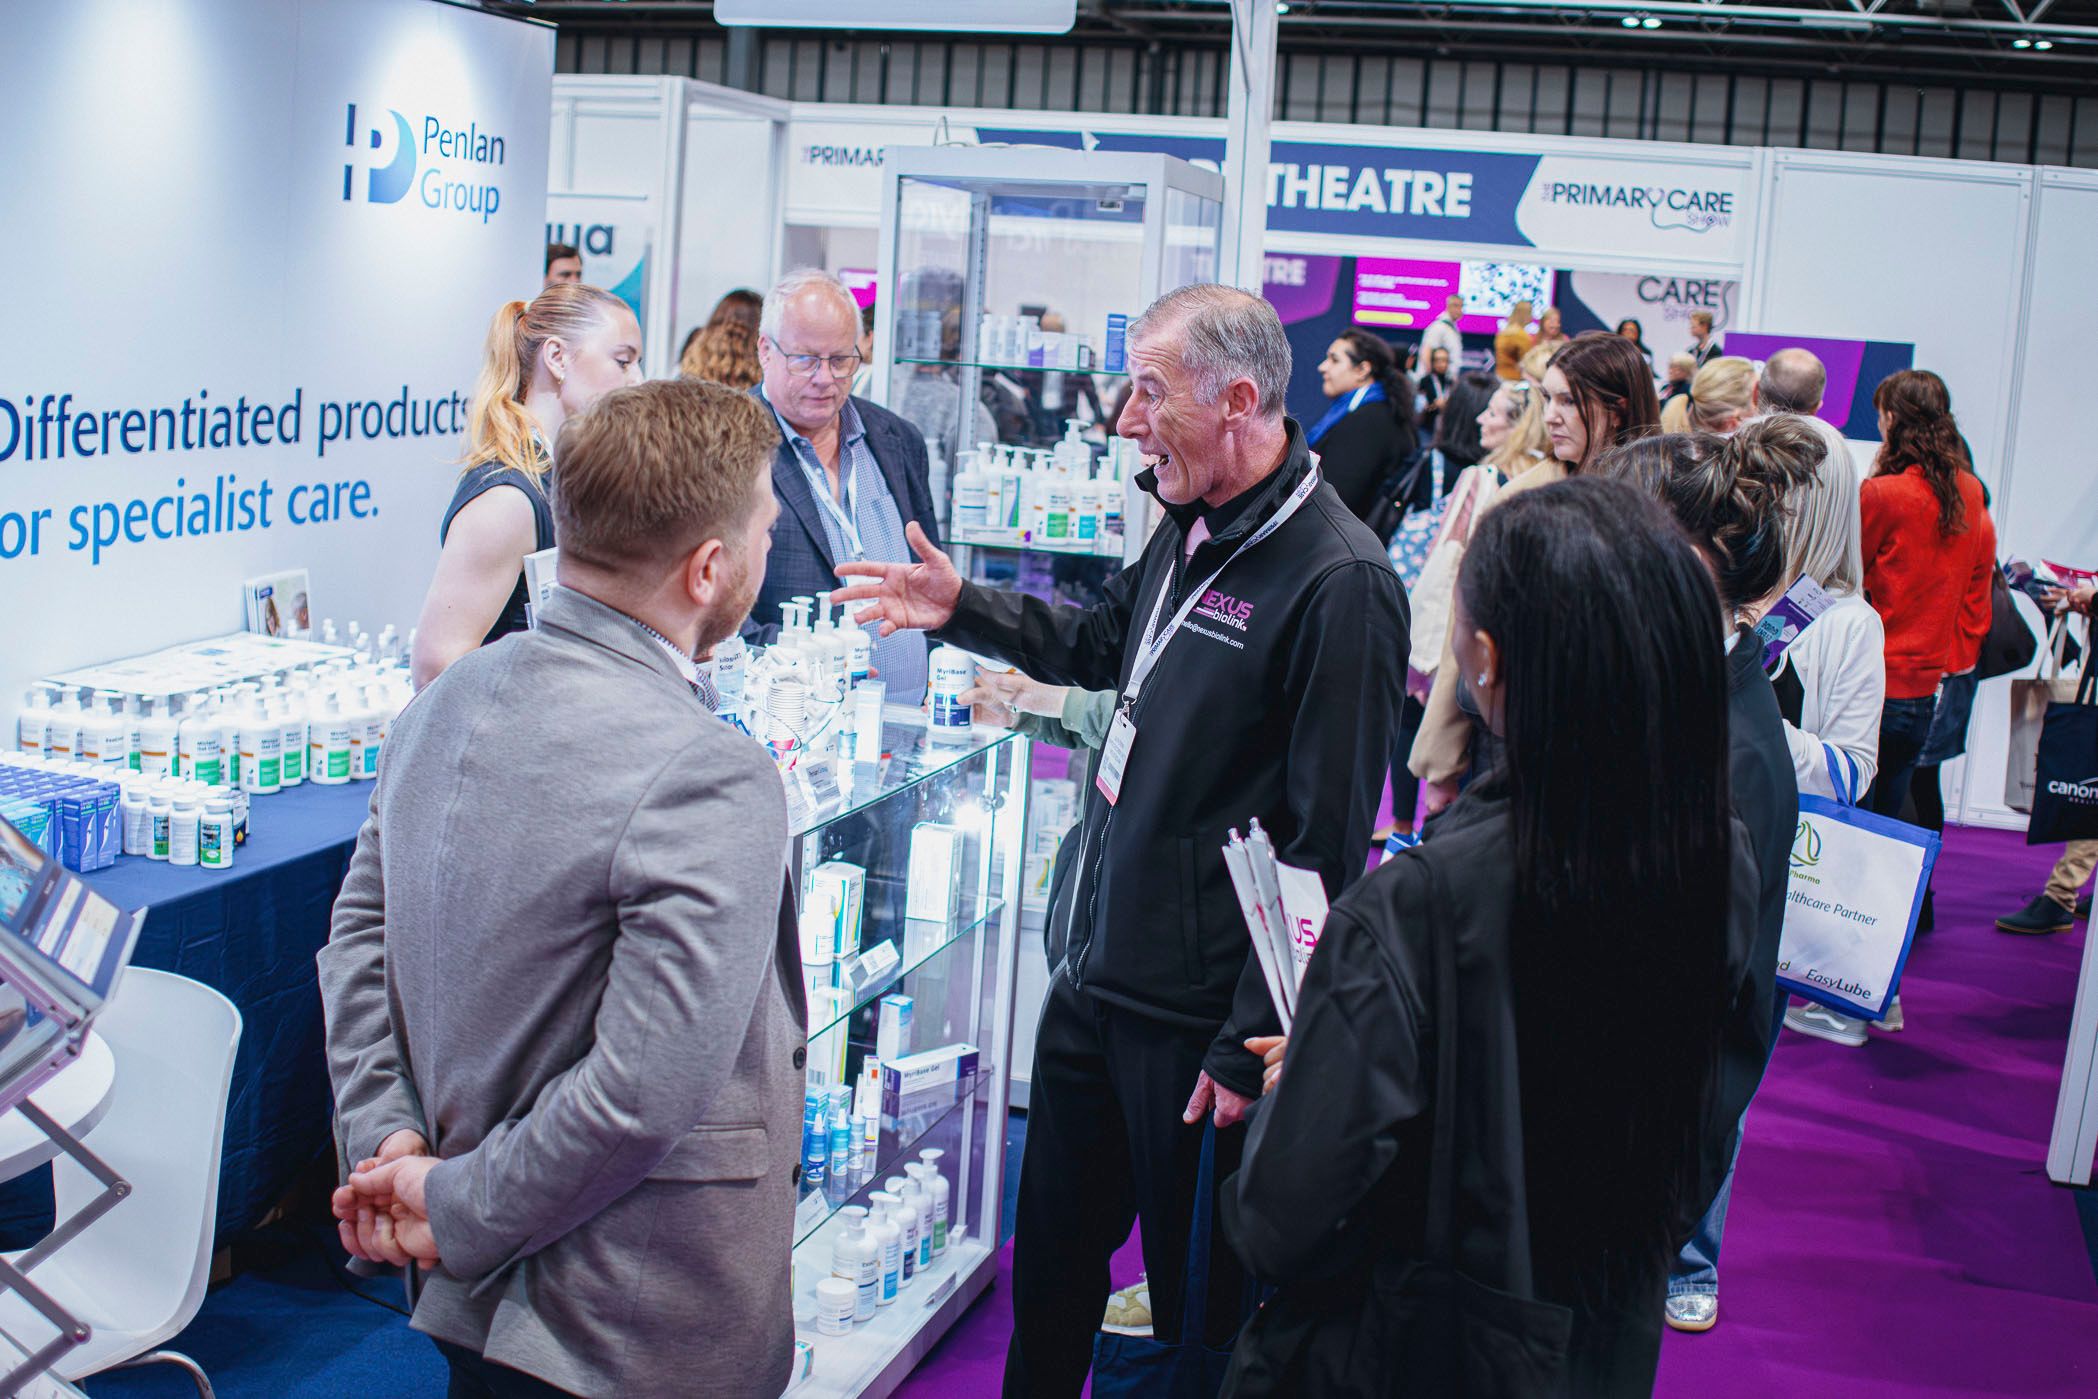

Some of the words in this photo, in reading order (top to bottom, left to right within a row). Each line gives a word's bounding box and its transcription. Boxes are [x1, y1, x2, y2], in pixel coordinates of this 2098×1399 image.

[423, 115, 504, 164] Penlan
[420, 167, 500, 225] Group
[1265, 163, 1474, 217] THEATRE
[1552, 183, 1665, 208] PRIMARY
[1667, 189, 1735, 214] CARE
[1637, 276, 1719, 306] CARE
[68, 473, 273, 566] specialist
[287, 479, 379, 525] care.
[1789, 870, 1821, 885] Pharma
[1833, 903, 1879, 926] Partner
[1805, 968, 1872, 1000] EasyLube
